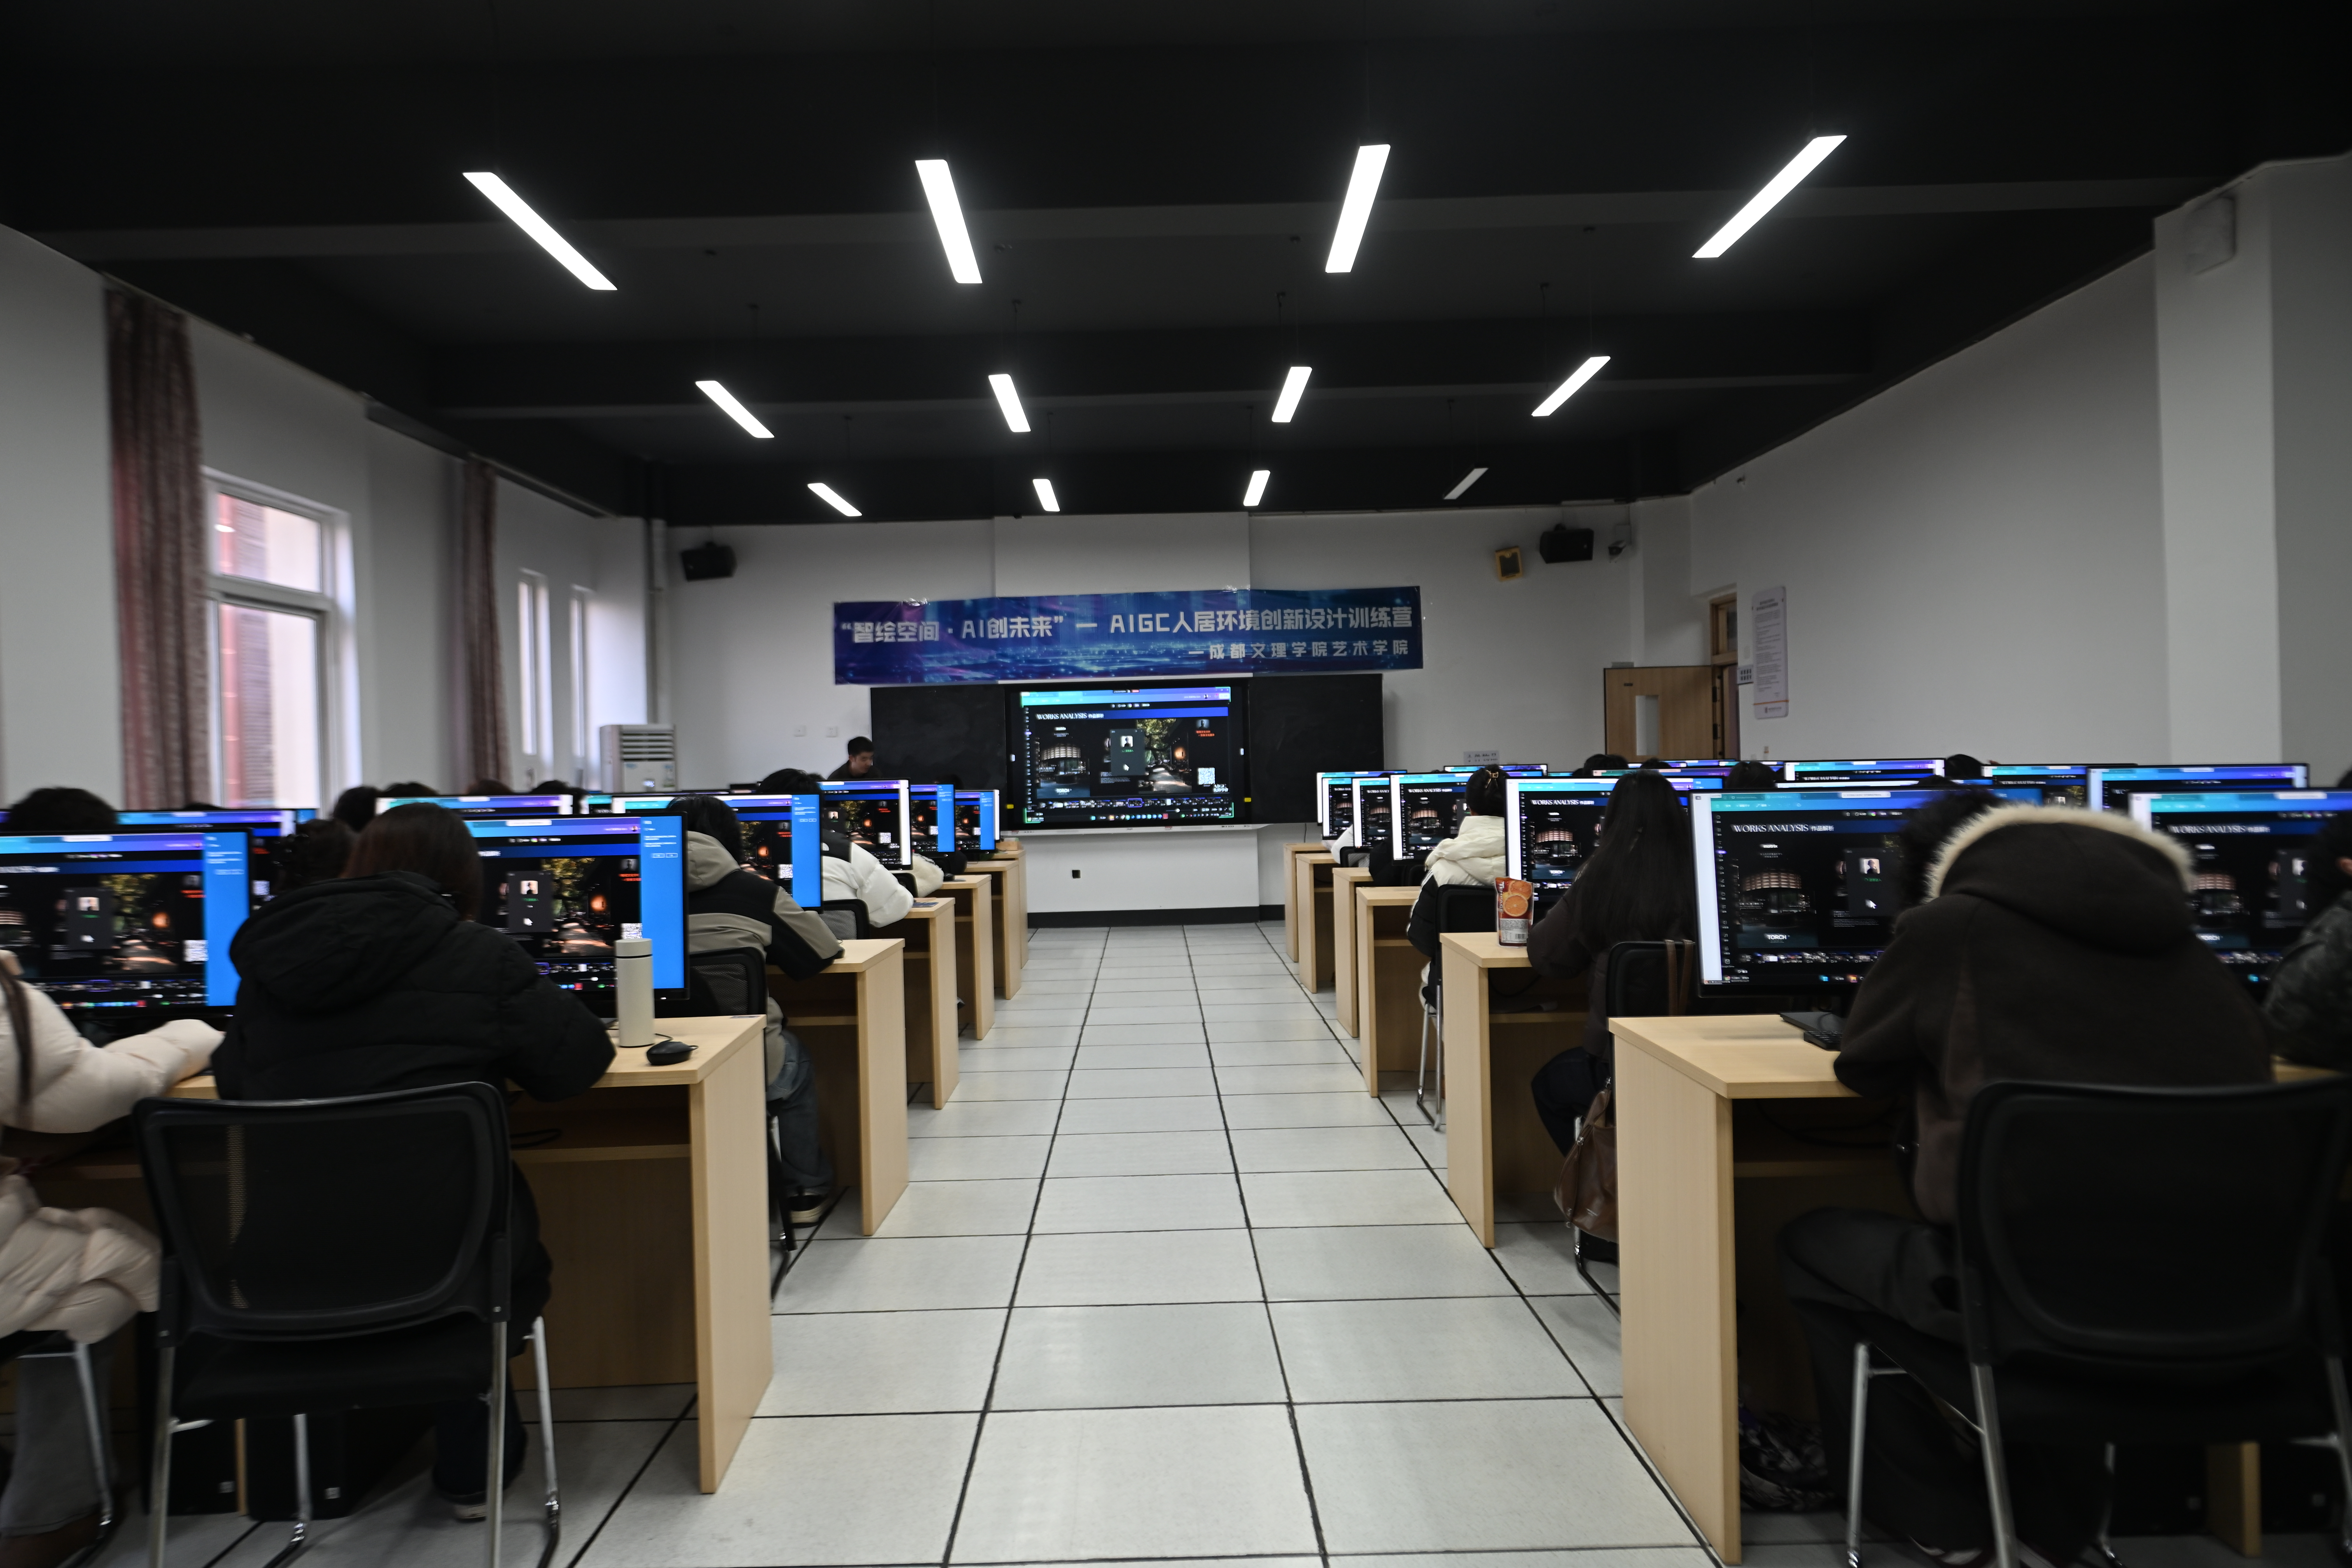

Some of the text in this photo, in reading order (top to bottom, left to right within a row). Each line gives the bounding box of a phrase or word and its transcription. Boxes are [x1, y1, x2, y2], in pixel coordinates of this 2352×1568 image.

[1111, 607, 1412, 633] AIGC人居环境创新设计训练营
[1732, 824, 1767, 832] WORKS
[1768, 824, 1809, 832] ANALYSIS
[2169, 825, 2204, 833] WORKS
[2205, 825, 2246, 833] ANALYSIS
